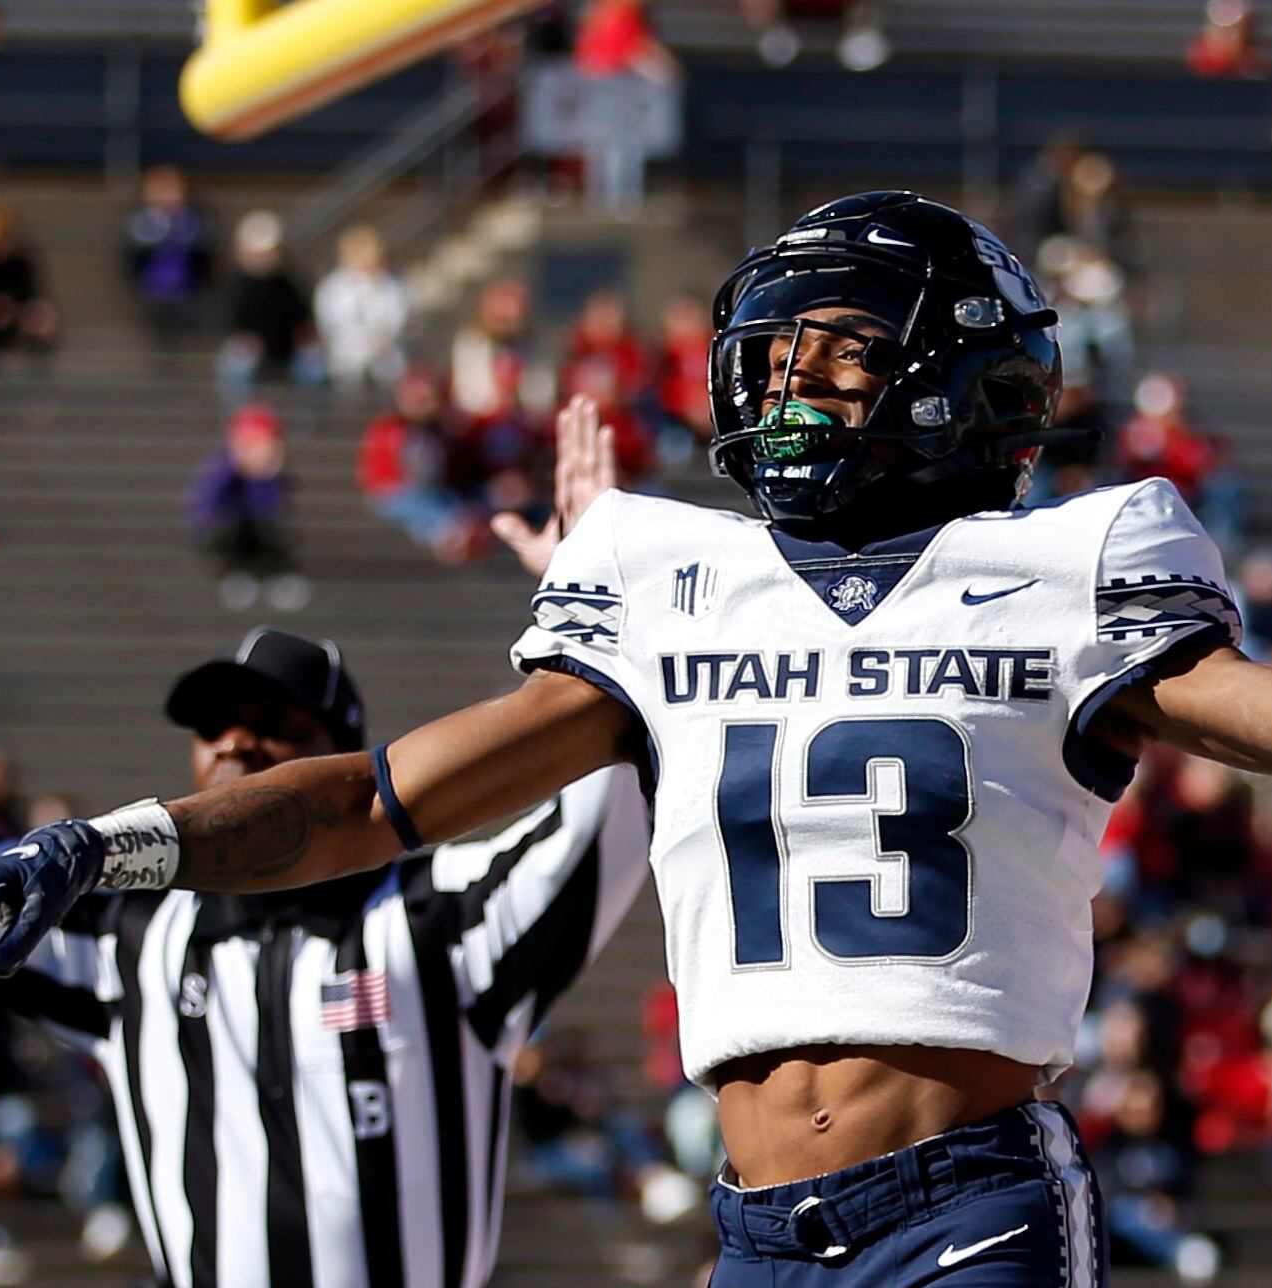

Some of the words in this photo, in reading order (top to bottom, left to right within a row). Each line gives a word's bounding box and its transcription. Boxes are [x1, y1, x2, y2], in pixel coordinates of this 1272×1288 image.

[659, 649, 823, 704] UTAH
[846, 648, 1057, 702] STATE
[714, 715, 976, 973] 13
[180, 972, 207, 1018] S
[348, 1080, 388, 1139] B
